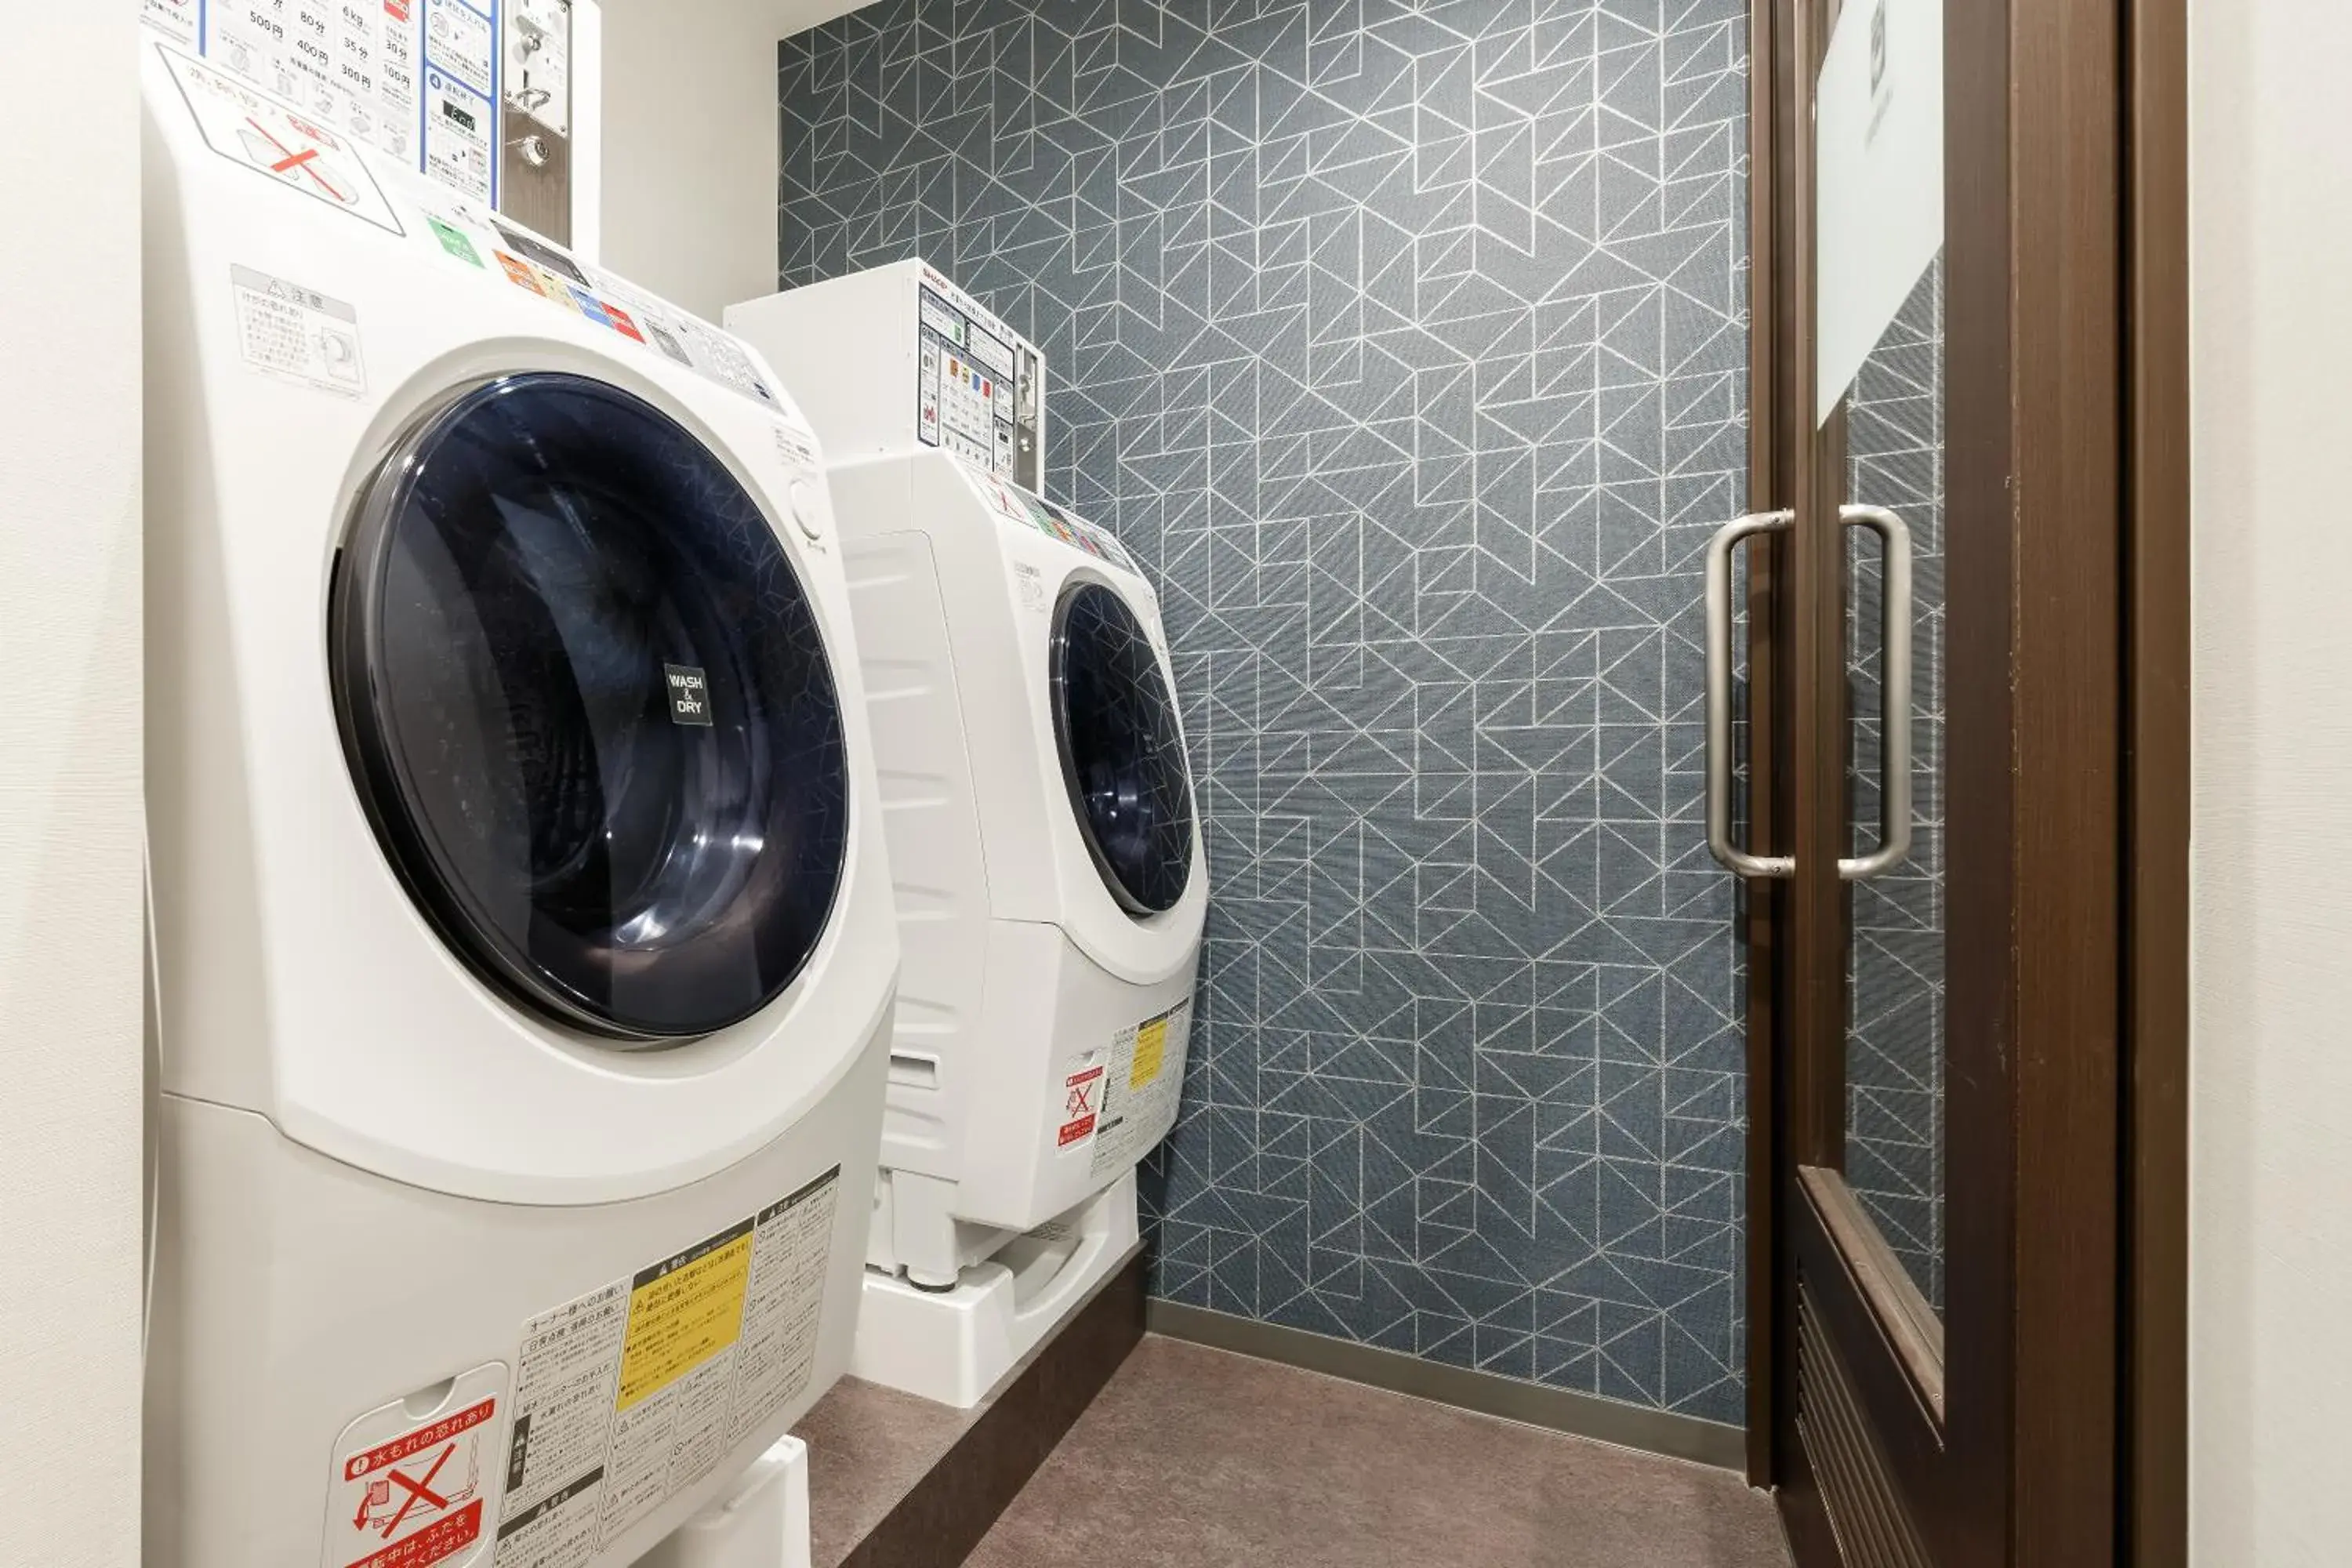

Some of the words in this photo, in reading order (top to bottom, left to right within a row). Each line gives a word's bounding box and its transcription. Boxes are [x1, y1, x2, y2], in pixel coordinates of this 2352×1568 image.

[250, 10, 283, 38] 500円
[301, 11, 325, 34] 80分
[297, 40, 328, 66] 400円
[344, 37, 368, 60] 35分
[341, 64, 371, 89] 300円
[383, 64, 410, 89] 100円
[669, 673, 703, 689] WASH
[677, 700, 702, 714] DRY
[684, 688, 694, 702] &
[372, 1403, 491, 1468] 水もれの恐れあり
